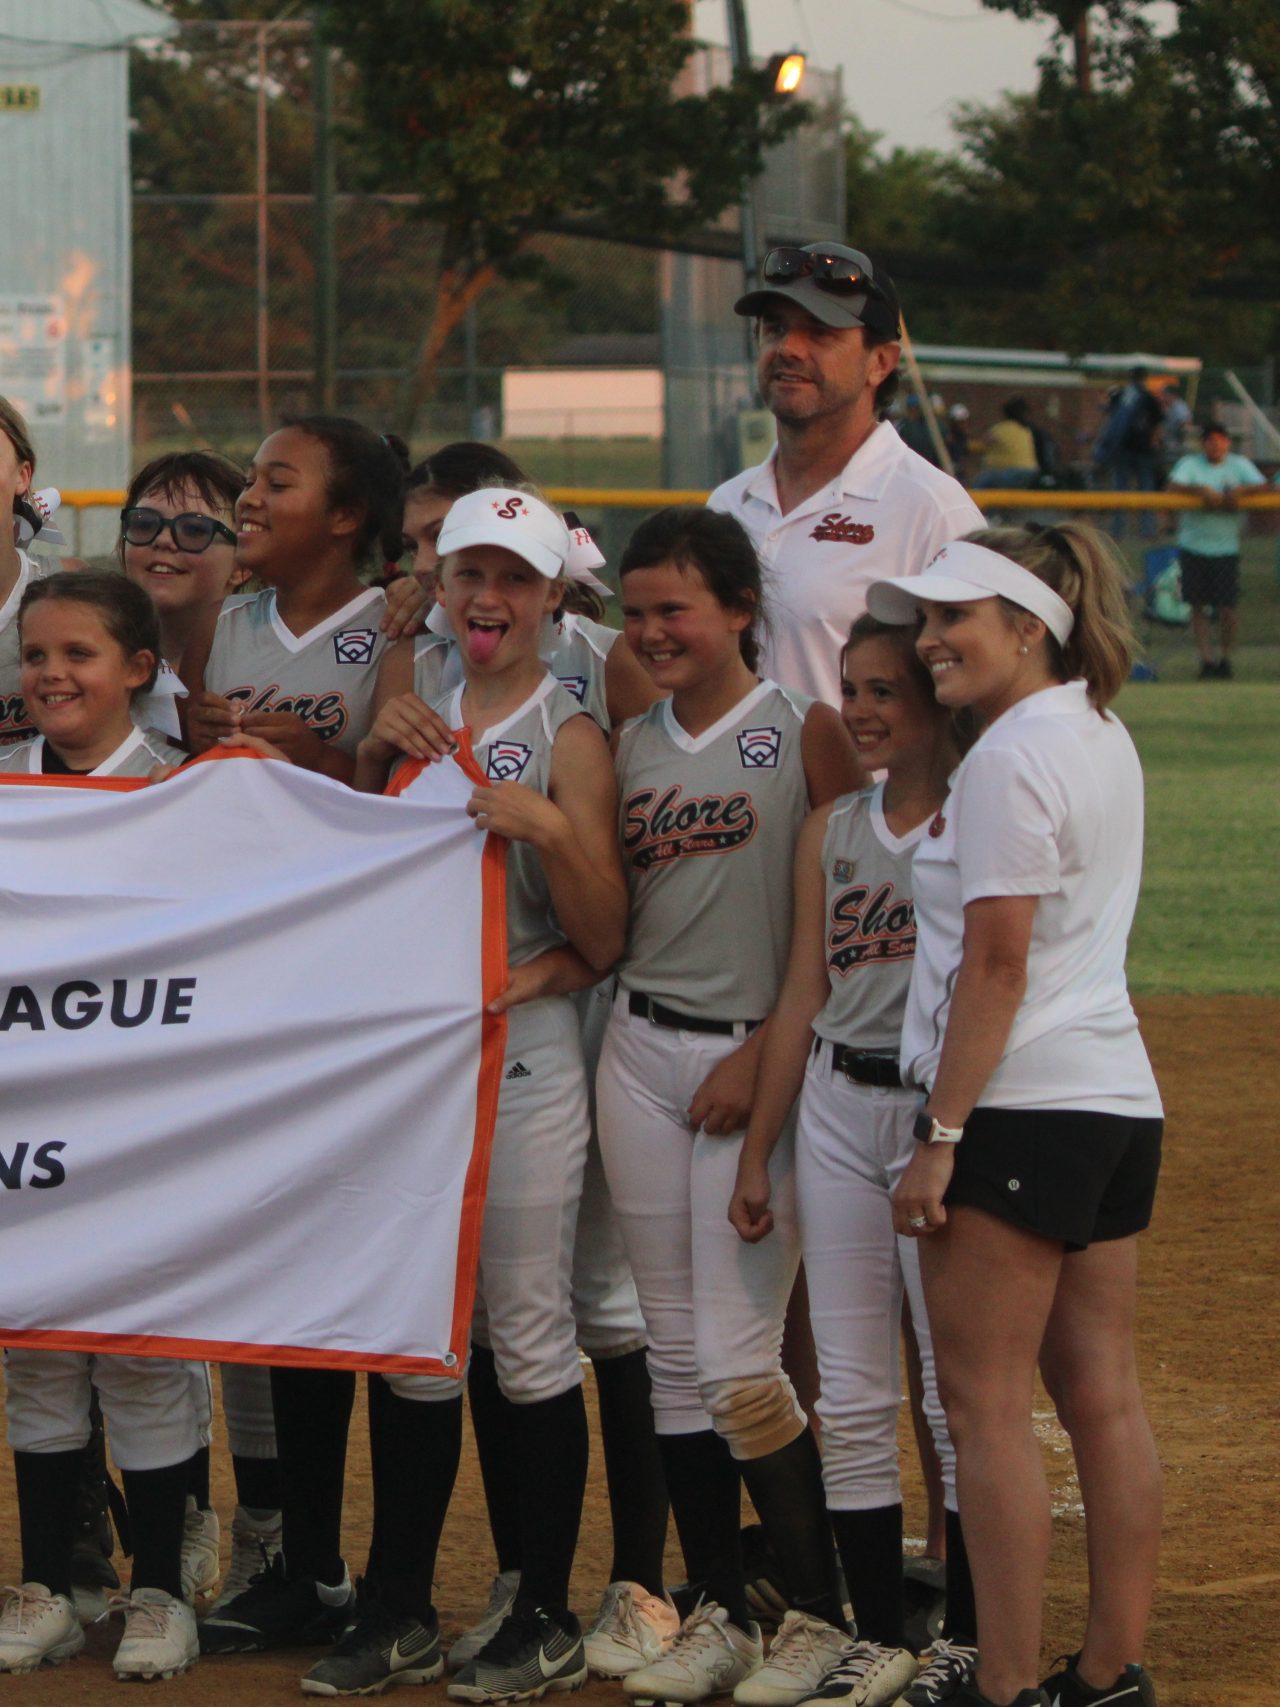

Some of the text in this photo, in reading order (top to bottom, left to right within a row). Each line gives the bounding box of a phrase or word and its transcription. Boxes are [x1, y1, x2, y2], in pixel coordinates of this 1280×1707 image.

[496, 497, 523, 519] S
[623, 786, 754, 849] Shore
[829, 887, 917, 947] Sho
